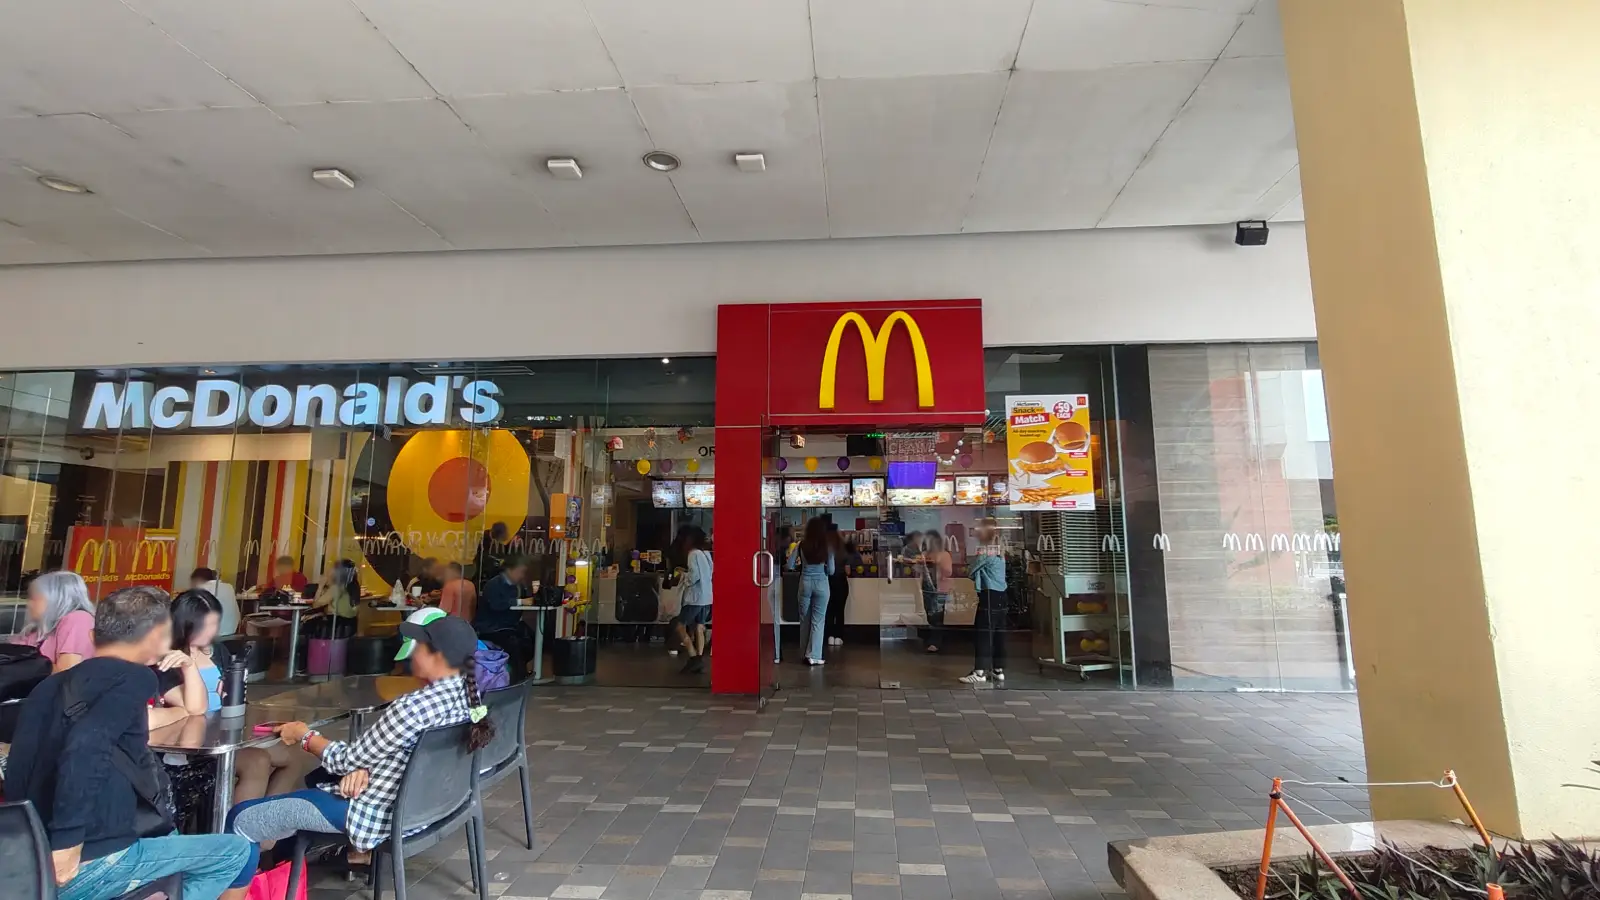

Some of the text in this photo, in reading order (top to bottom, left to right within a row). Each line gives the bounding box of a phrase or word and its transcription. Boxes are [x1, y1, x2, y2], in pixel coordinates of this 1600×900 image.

[82, 375, 502, 429] McDonald's
[1015, 414, 1045, 424] Match
[125, 573, 170, 581] McDonald's
